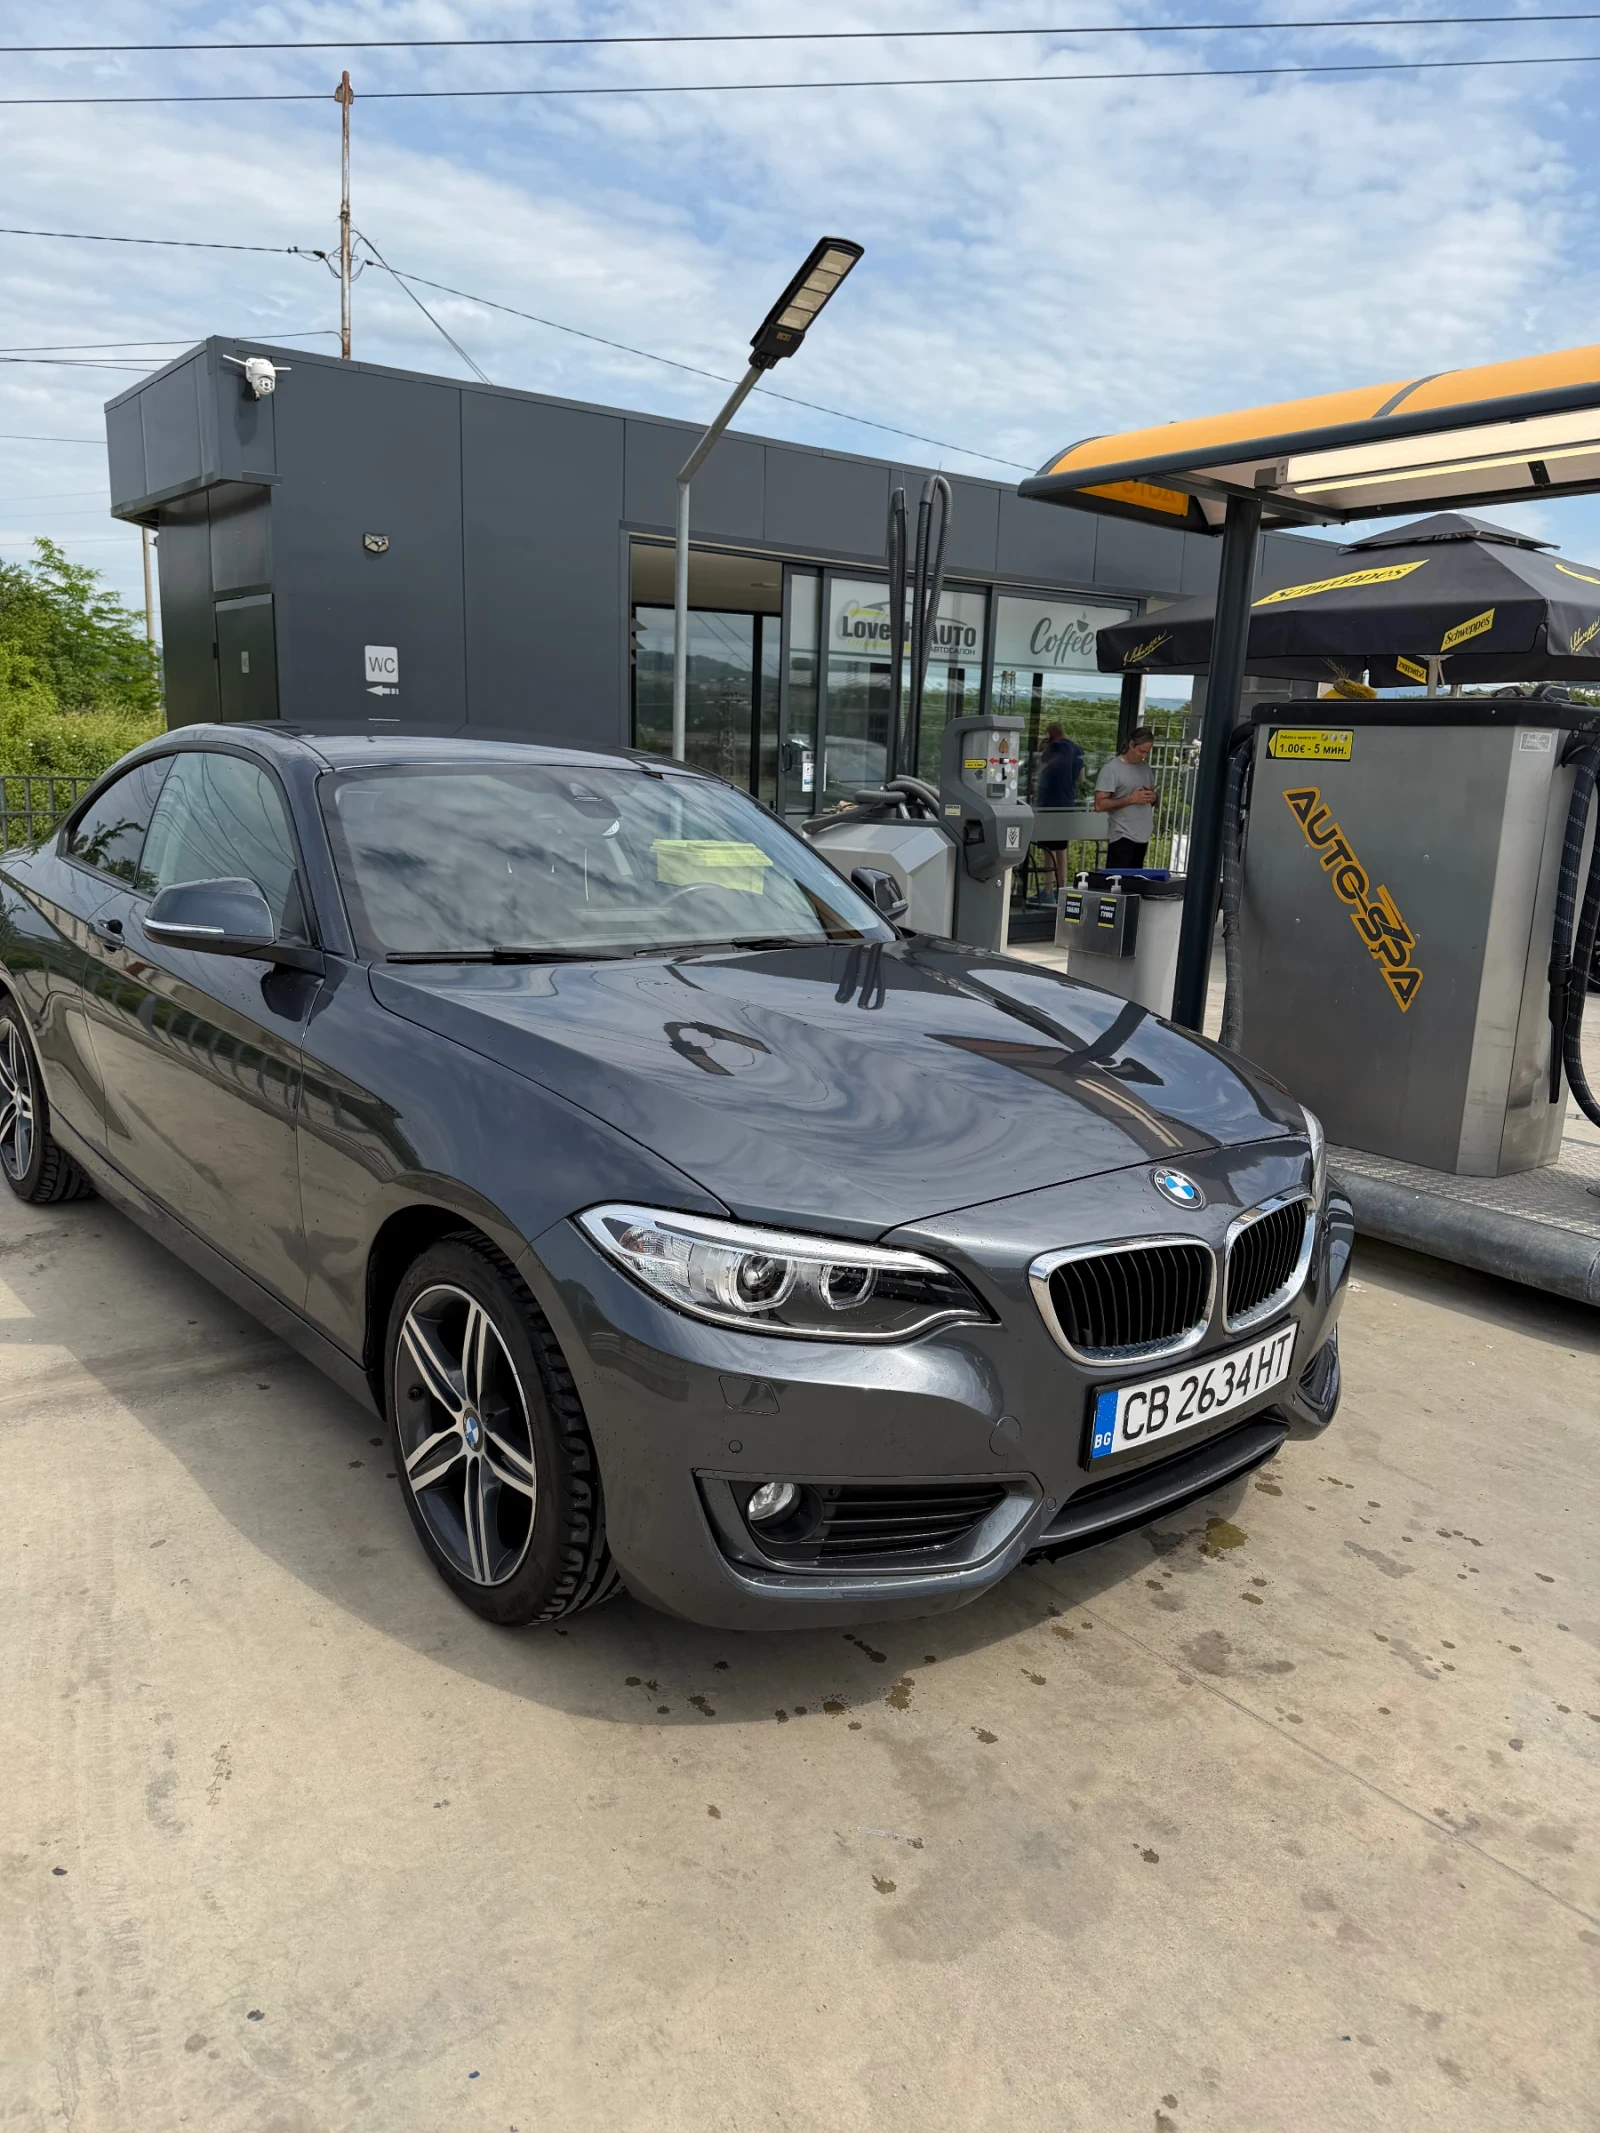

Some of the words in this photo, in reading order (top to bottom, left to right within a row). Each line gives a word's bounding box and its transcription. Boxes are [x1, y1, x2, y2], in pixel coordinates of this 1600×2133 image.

[1030, 617, 1095, 665] Coffee
[1445, 614, 1492, 645] Schweppes
[369, 656, 396, 674] WC
[1280, 744, 1306, 753] 1.00€
[1314, 744, 1320, 753] 5
[1323, 746, 1347, 754] мин.
[1123, 1384, 1170, 1440] CB
[1174, 1352, 1254, 1424] 2634
[1254, 1332, 1292, 1390] HT
[1094, 1432, 1111, 1449] BG
